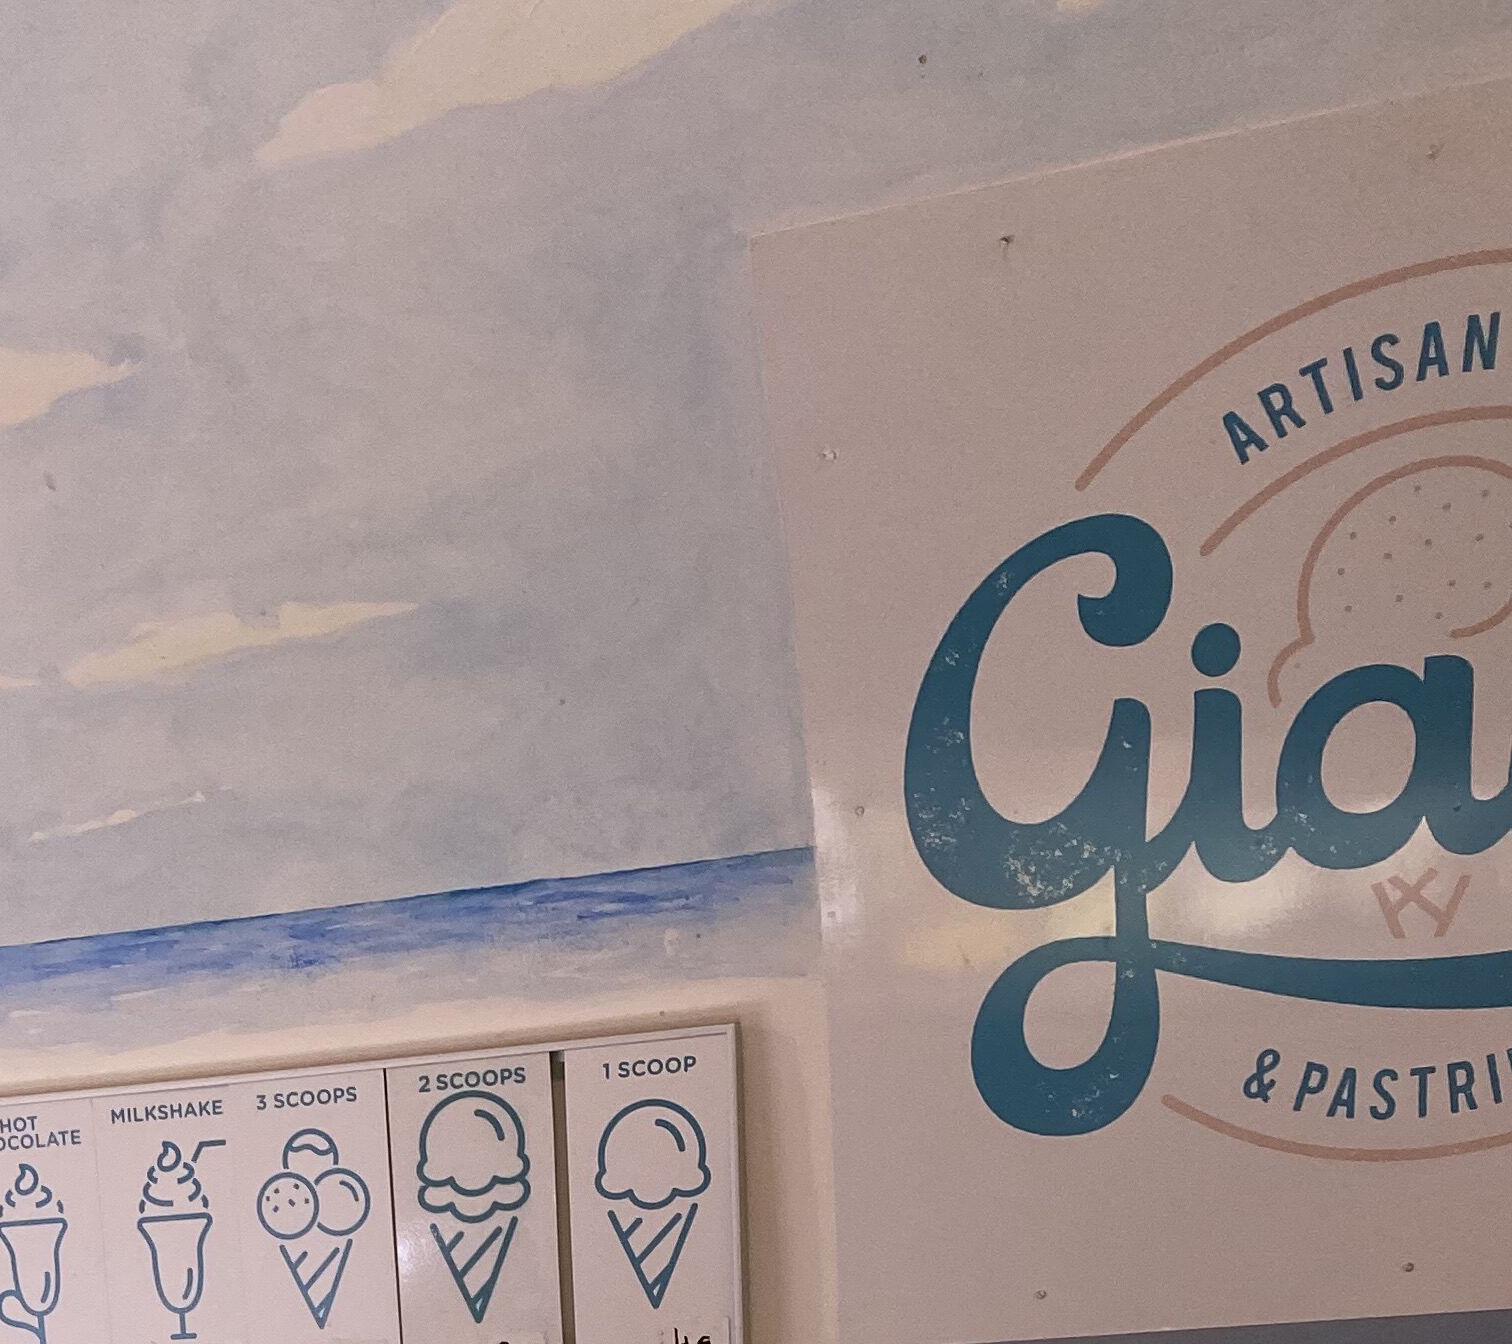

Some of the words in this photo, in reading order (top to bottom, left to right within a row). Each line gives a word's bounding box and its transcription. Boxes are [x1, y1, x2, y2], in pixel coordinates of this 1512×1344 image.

[1221, 310, 1502, 465] ARTISAN
[904, 513, 1512, 1136] Gia
[418, 1076, 431, 1092] 2
[436, 1067, 526, 1091] SCOOPS
[602, 1062, 609, 1079] 1
[617, 1056, 696, 1079] SCOOP
[1243, 1048, 1281, 1103] &
[1293, 1048, 1512, 1120] PASTRI
[256, 1094, 267, 1110] 3
[273, 1087, 357, 1108] SCOOPS
[0, 1115, 38, 1133] HOT
[110, 1099, 223, 1125] MILKSHAKE
